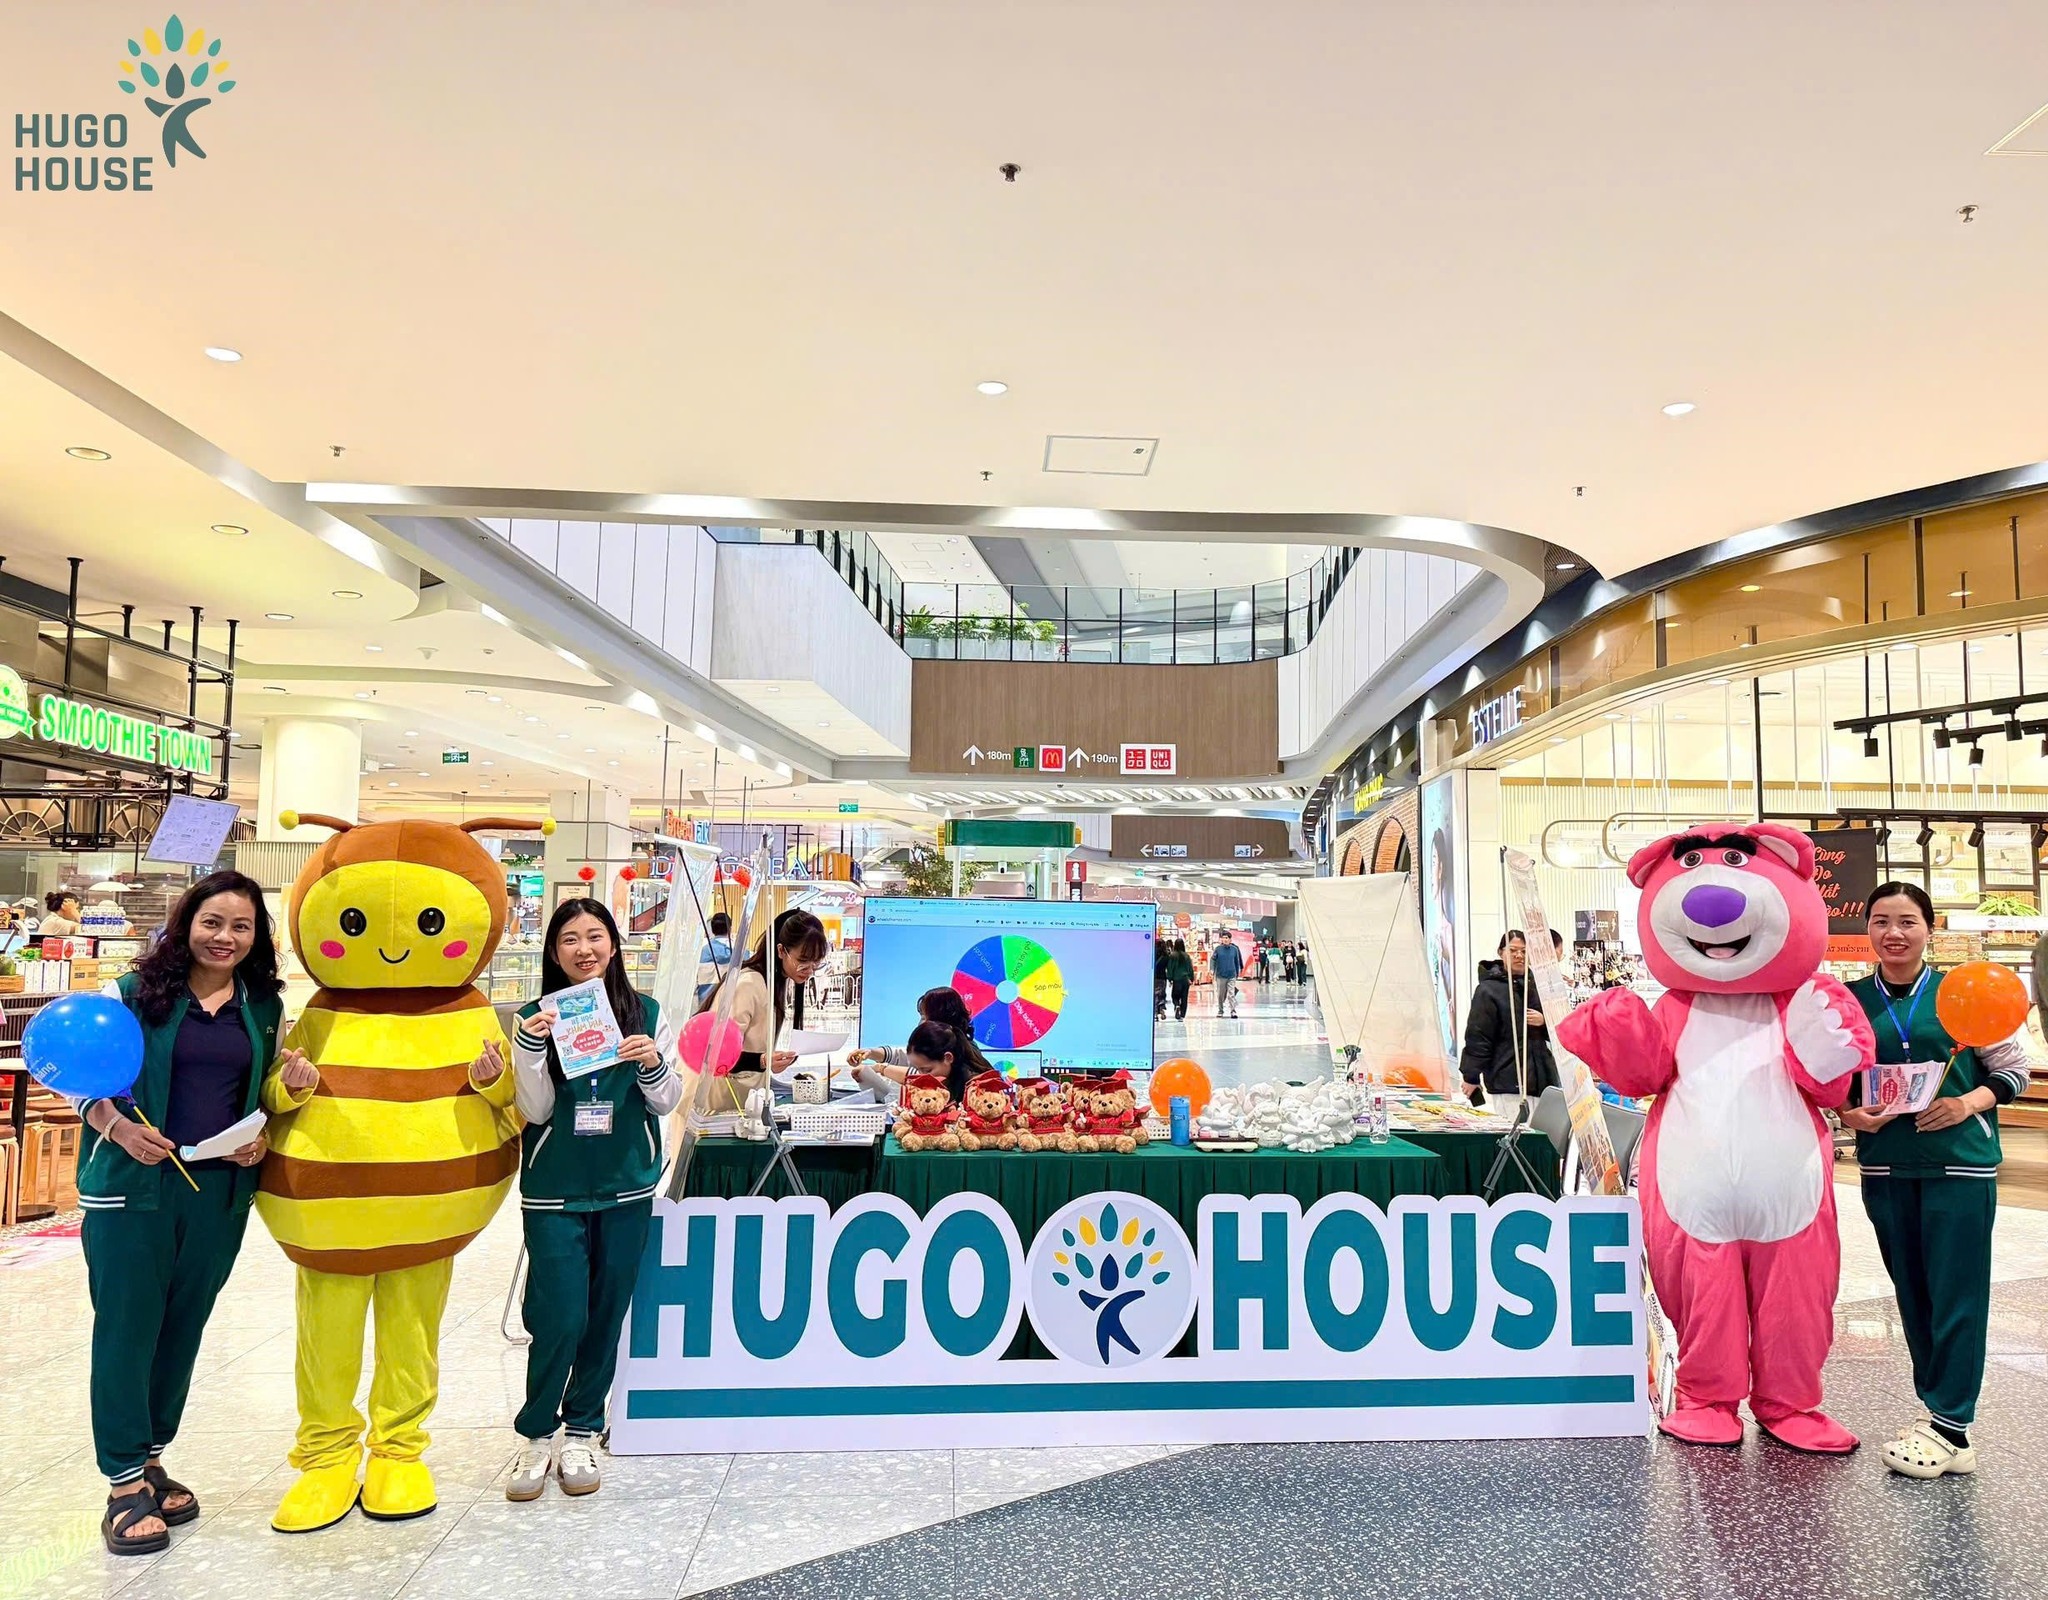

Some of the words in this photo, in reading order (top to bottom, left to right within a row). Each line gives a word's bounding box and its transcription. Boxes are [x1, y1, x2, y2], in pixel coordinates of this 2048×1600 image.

[41, 694, 156, 763] SMOOTHIE
[157, 725, 212, 775] TOWN
[1473, 685, 1525, 749] ESTELLE
[986, 751, 1011, 760] 180m
[1091, 754, 1117, 764] 190m
[629, 1210, 1011, 1359] HUGO
[1214, 1208, 1635, 1353] HOUSE
